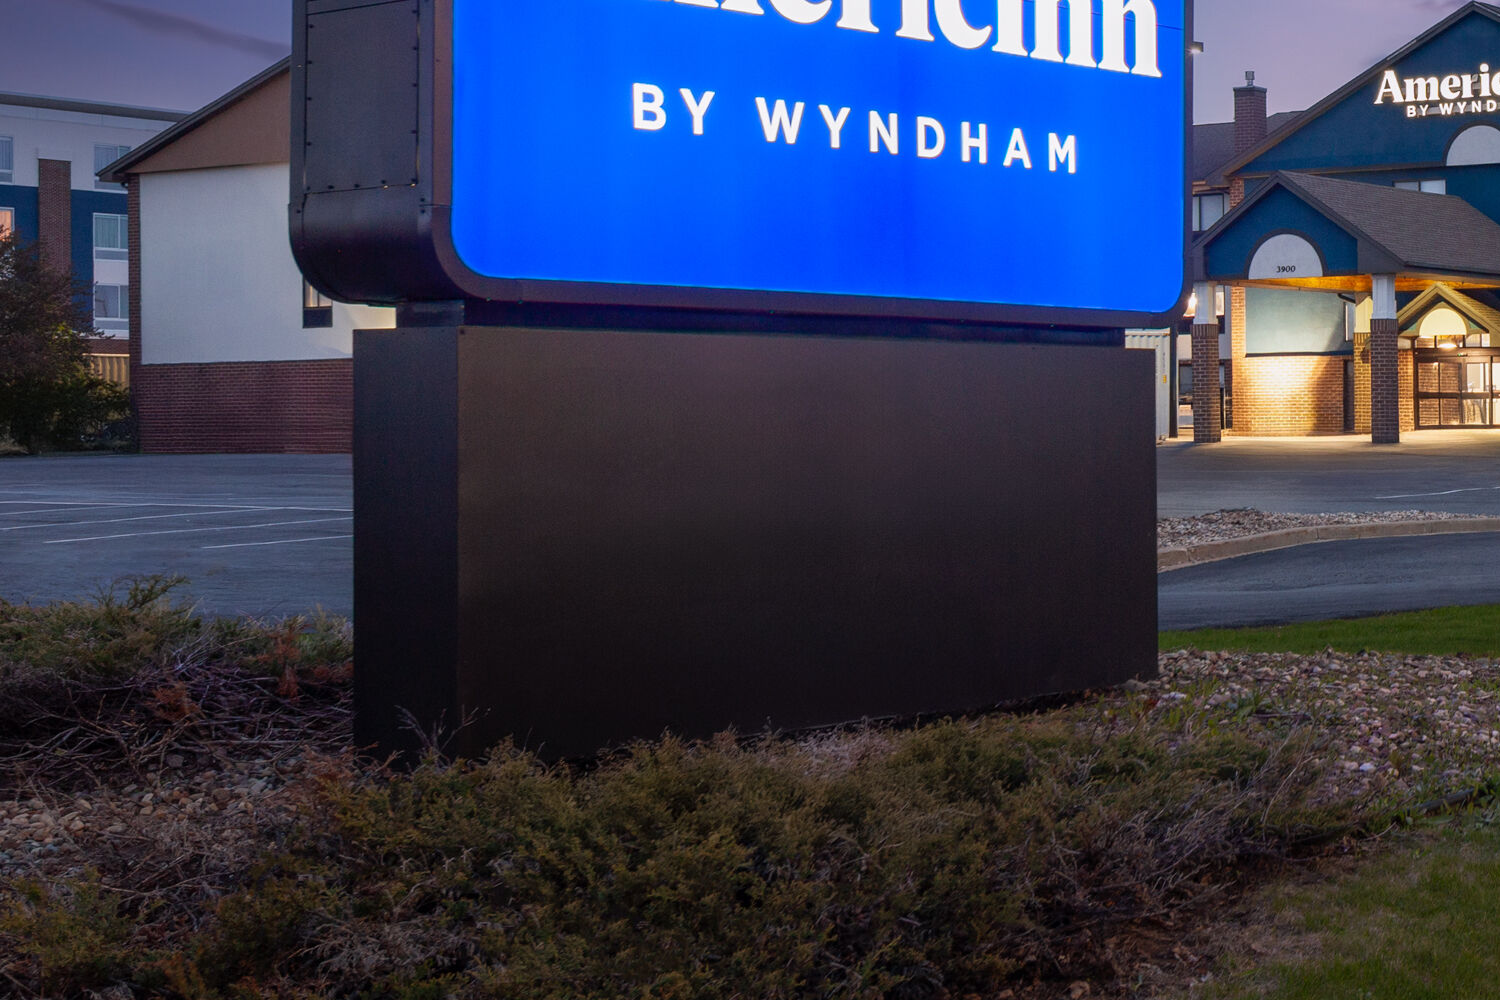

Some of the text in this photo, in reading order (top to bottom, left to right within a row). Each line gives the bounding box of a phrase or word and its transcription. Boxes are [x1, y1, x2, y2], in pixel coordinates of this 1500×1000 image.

[632, 82, 1077, 174] BY WYNDHAM
[1406, 104, 1429, 118] BY
